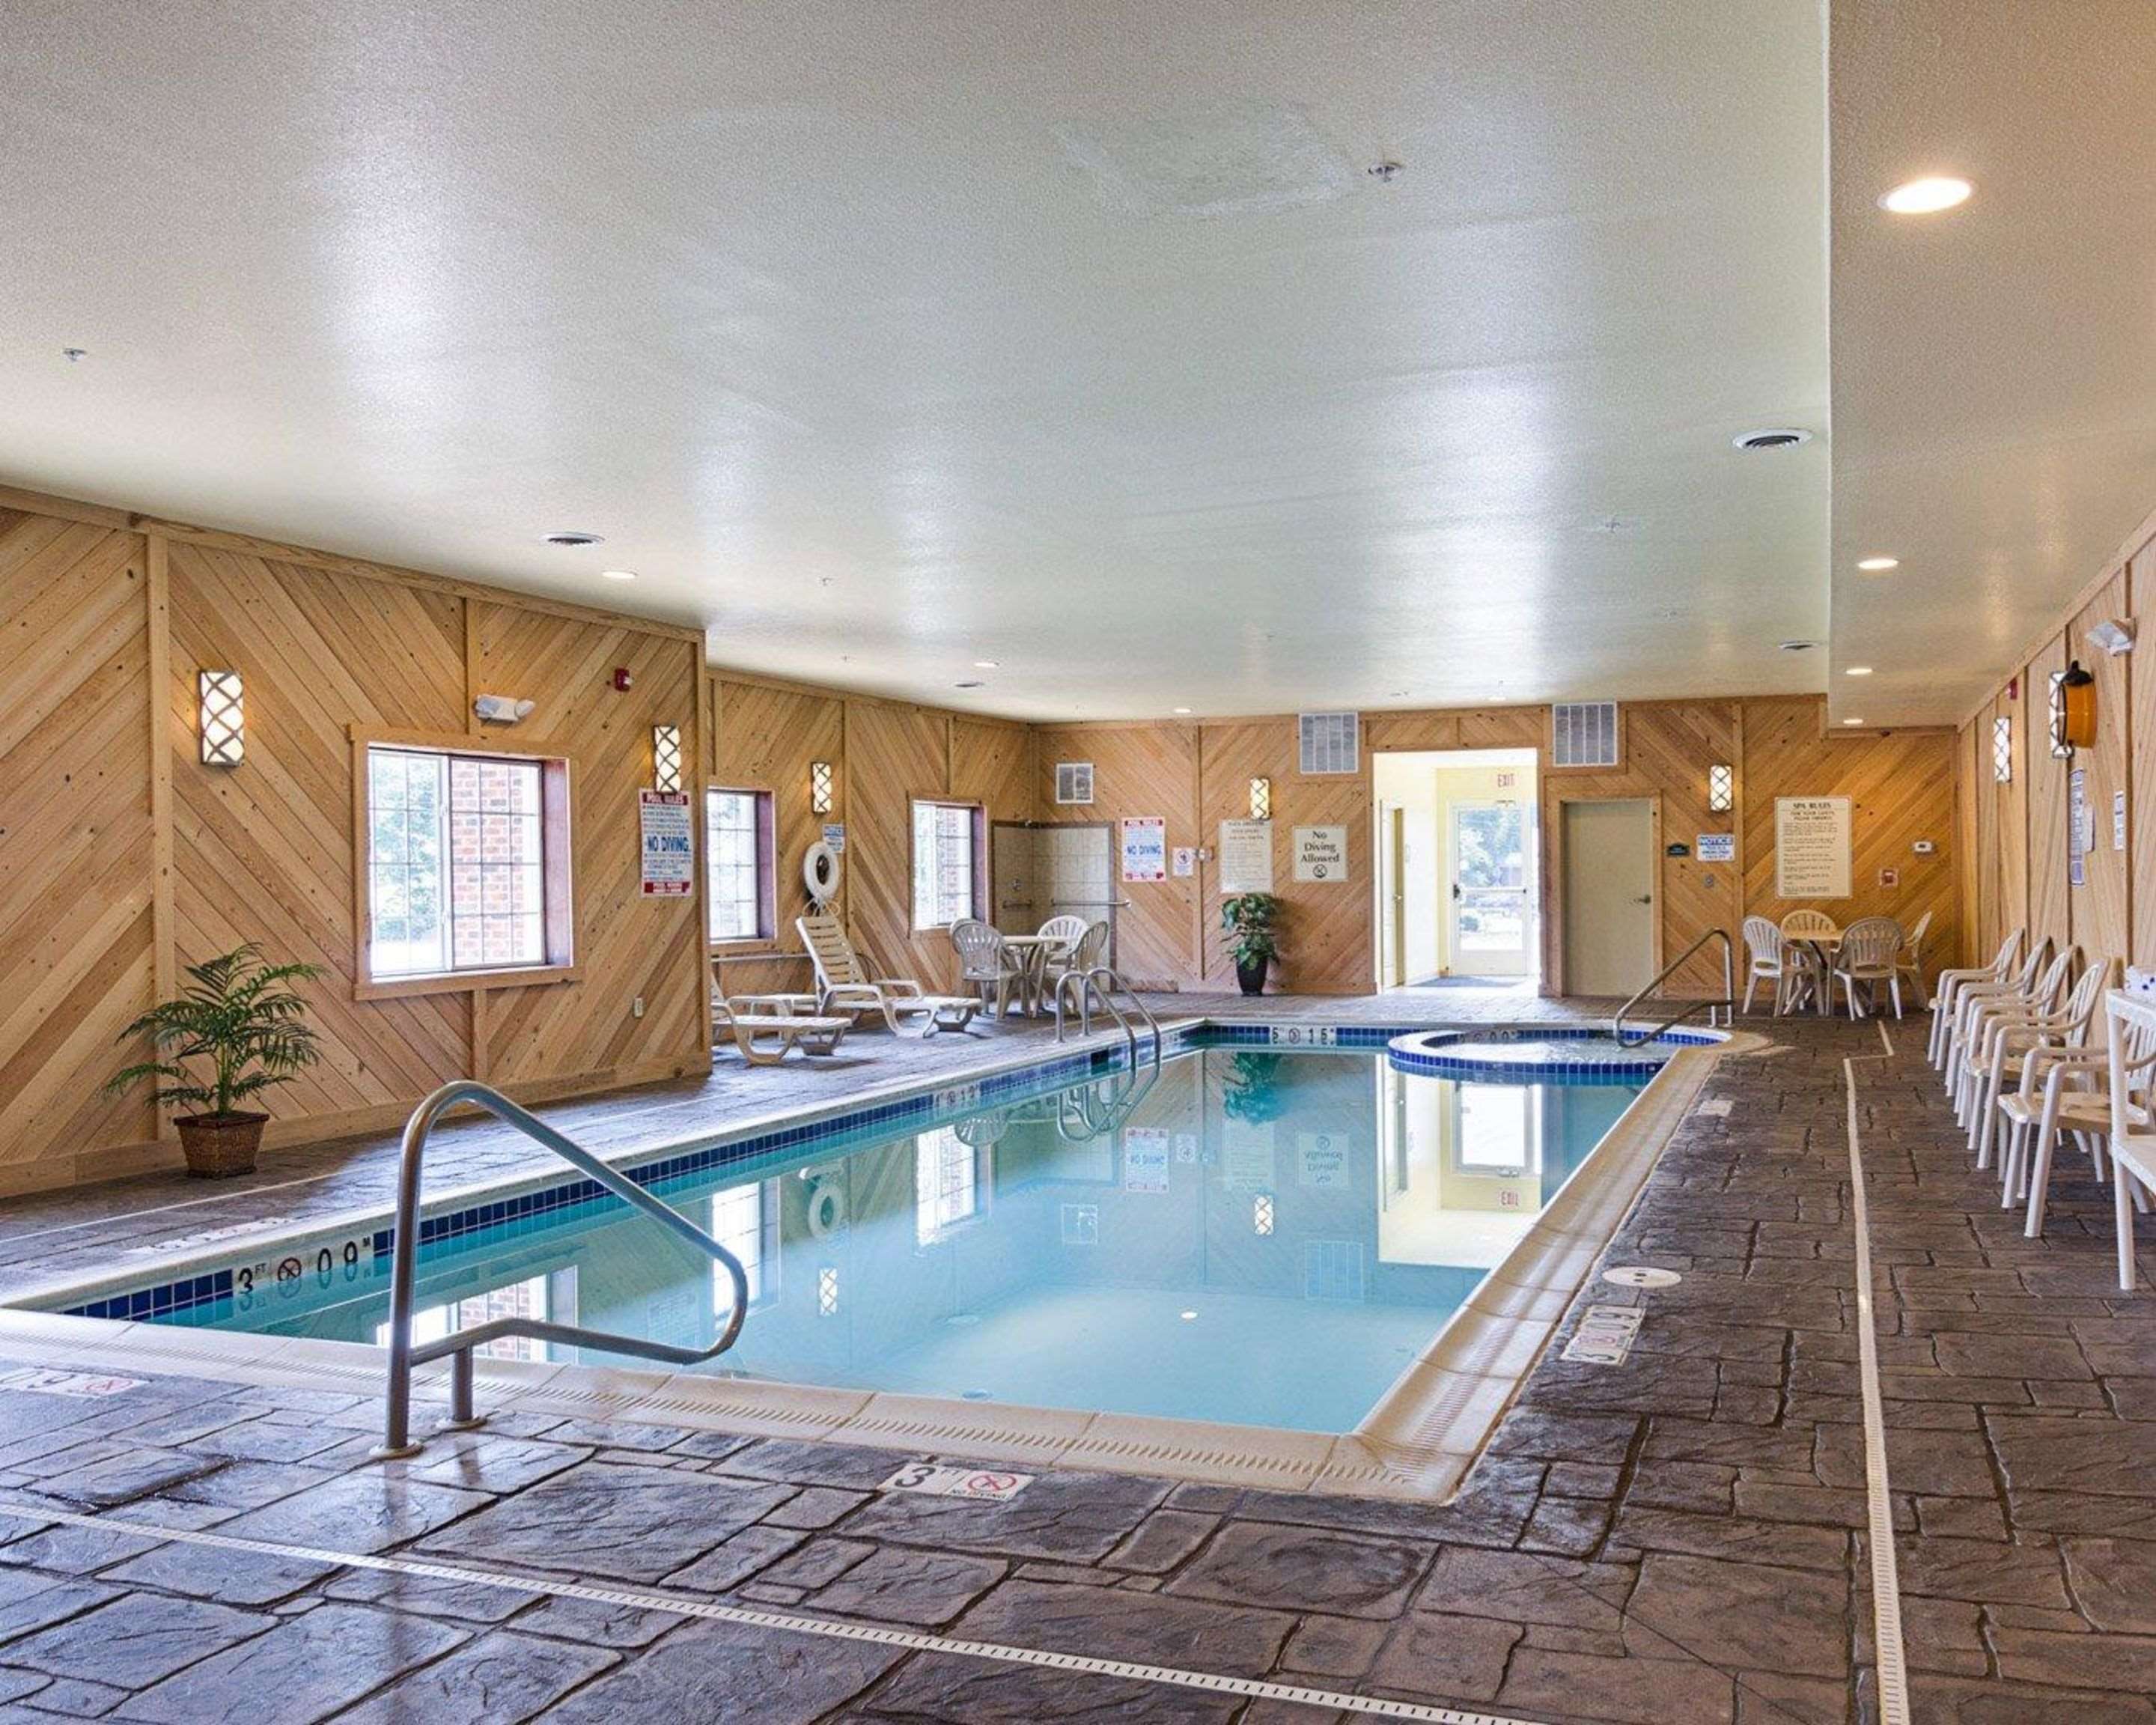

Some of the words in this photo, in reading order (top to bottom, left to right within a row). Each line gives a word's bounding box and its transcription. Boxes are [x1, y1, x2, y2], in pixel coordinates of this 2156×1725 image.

[1312, 830, 1327, 839] No
[648, 836, 659, 851] NO
[1304, 842, 1336, 853] Diving
[1127, 846, 1136, 855] NO
[1139, 845, 1161, 855] DIVING
[1301, 854, 1340, 862] Allowed
[238, 1268, 253, 1294] 3
[255, 1262, 267, 1274] FT
[895, 1466, 936, 1488] 3
